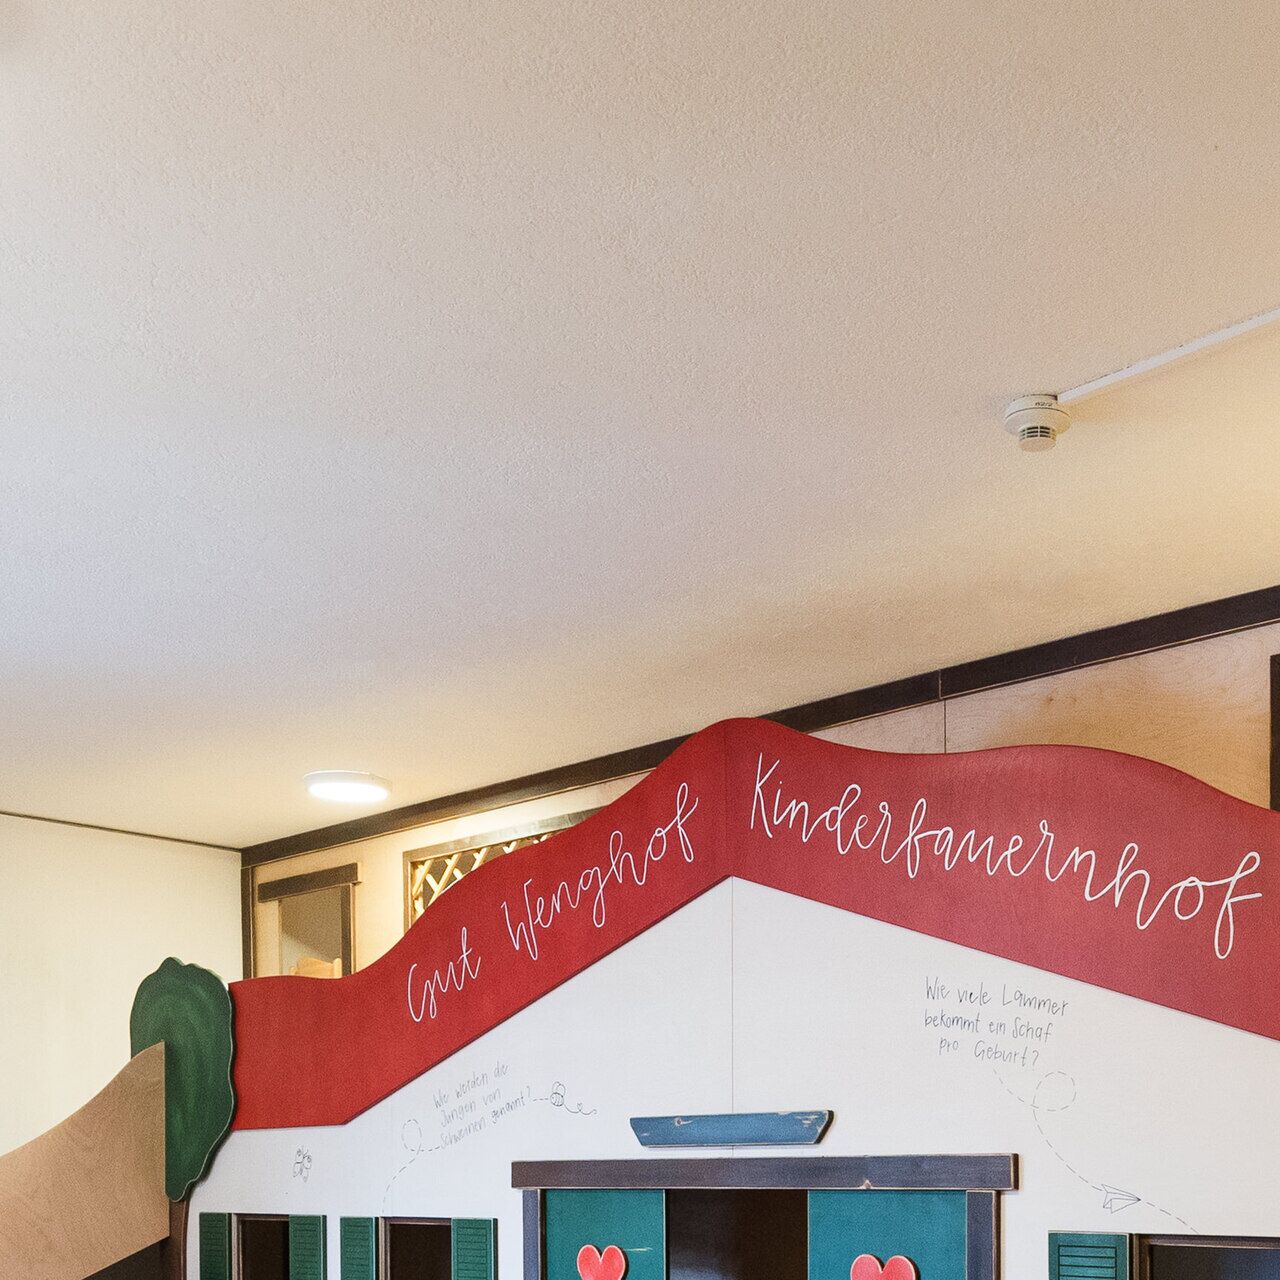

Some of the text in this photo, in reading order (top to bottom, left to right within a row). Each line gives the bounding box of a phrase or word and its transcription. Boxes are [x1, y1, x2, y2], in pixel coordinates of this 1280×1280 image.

[407, 927, 481, 1022] Gut
[500, 782, 699, 961] Wenghof
[925, 976, 951, 1001] Wie
[957, 981, 992, 1007] viele
[924, 1008, 1054, 1043] bekommt ein Schaf
[938, 1037, 1040, 1070] pro Geburt?
[482, 1088, 501, 1106] von
